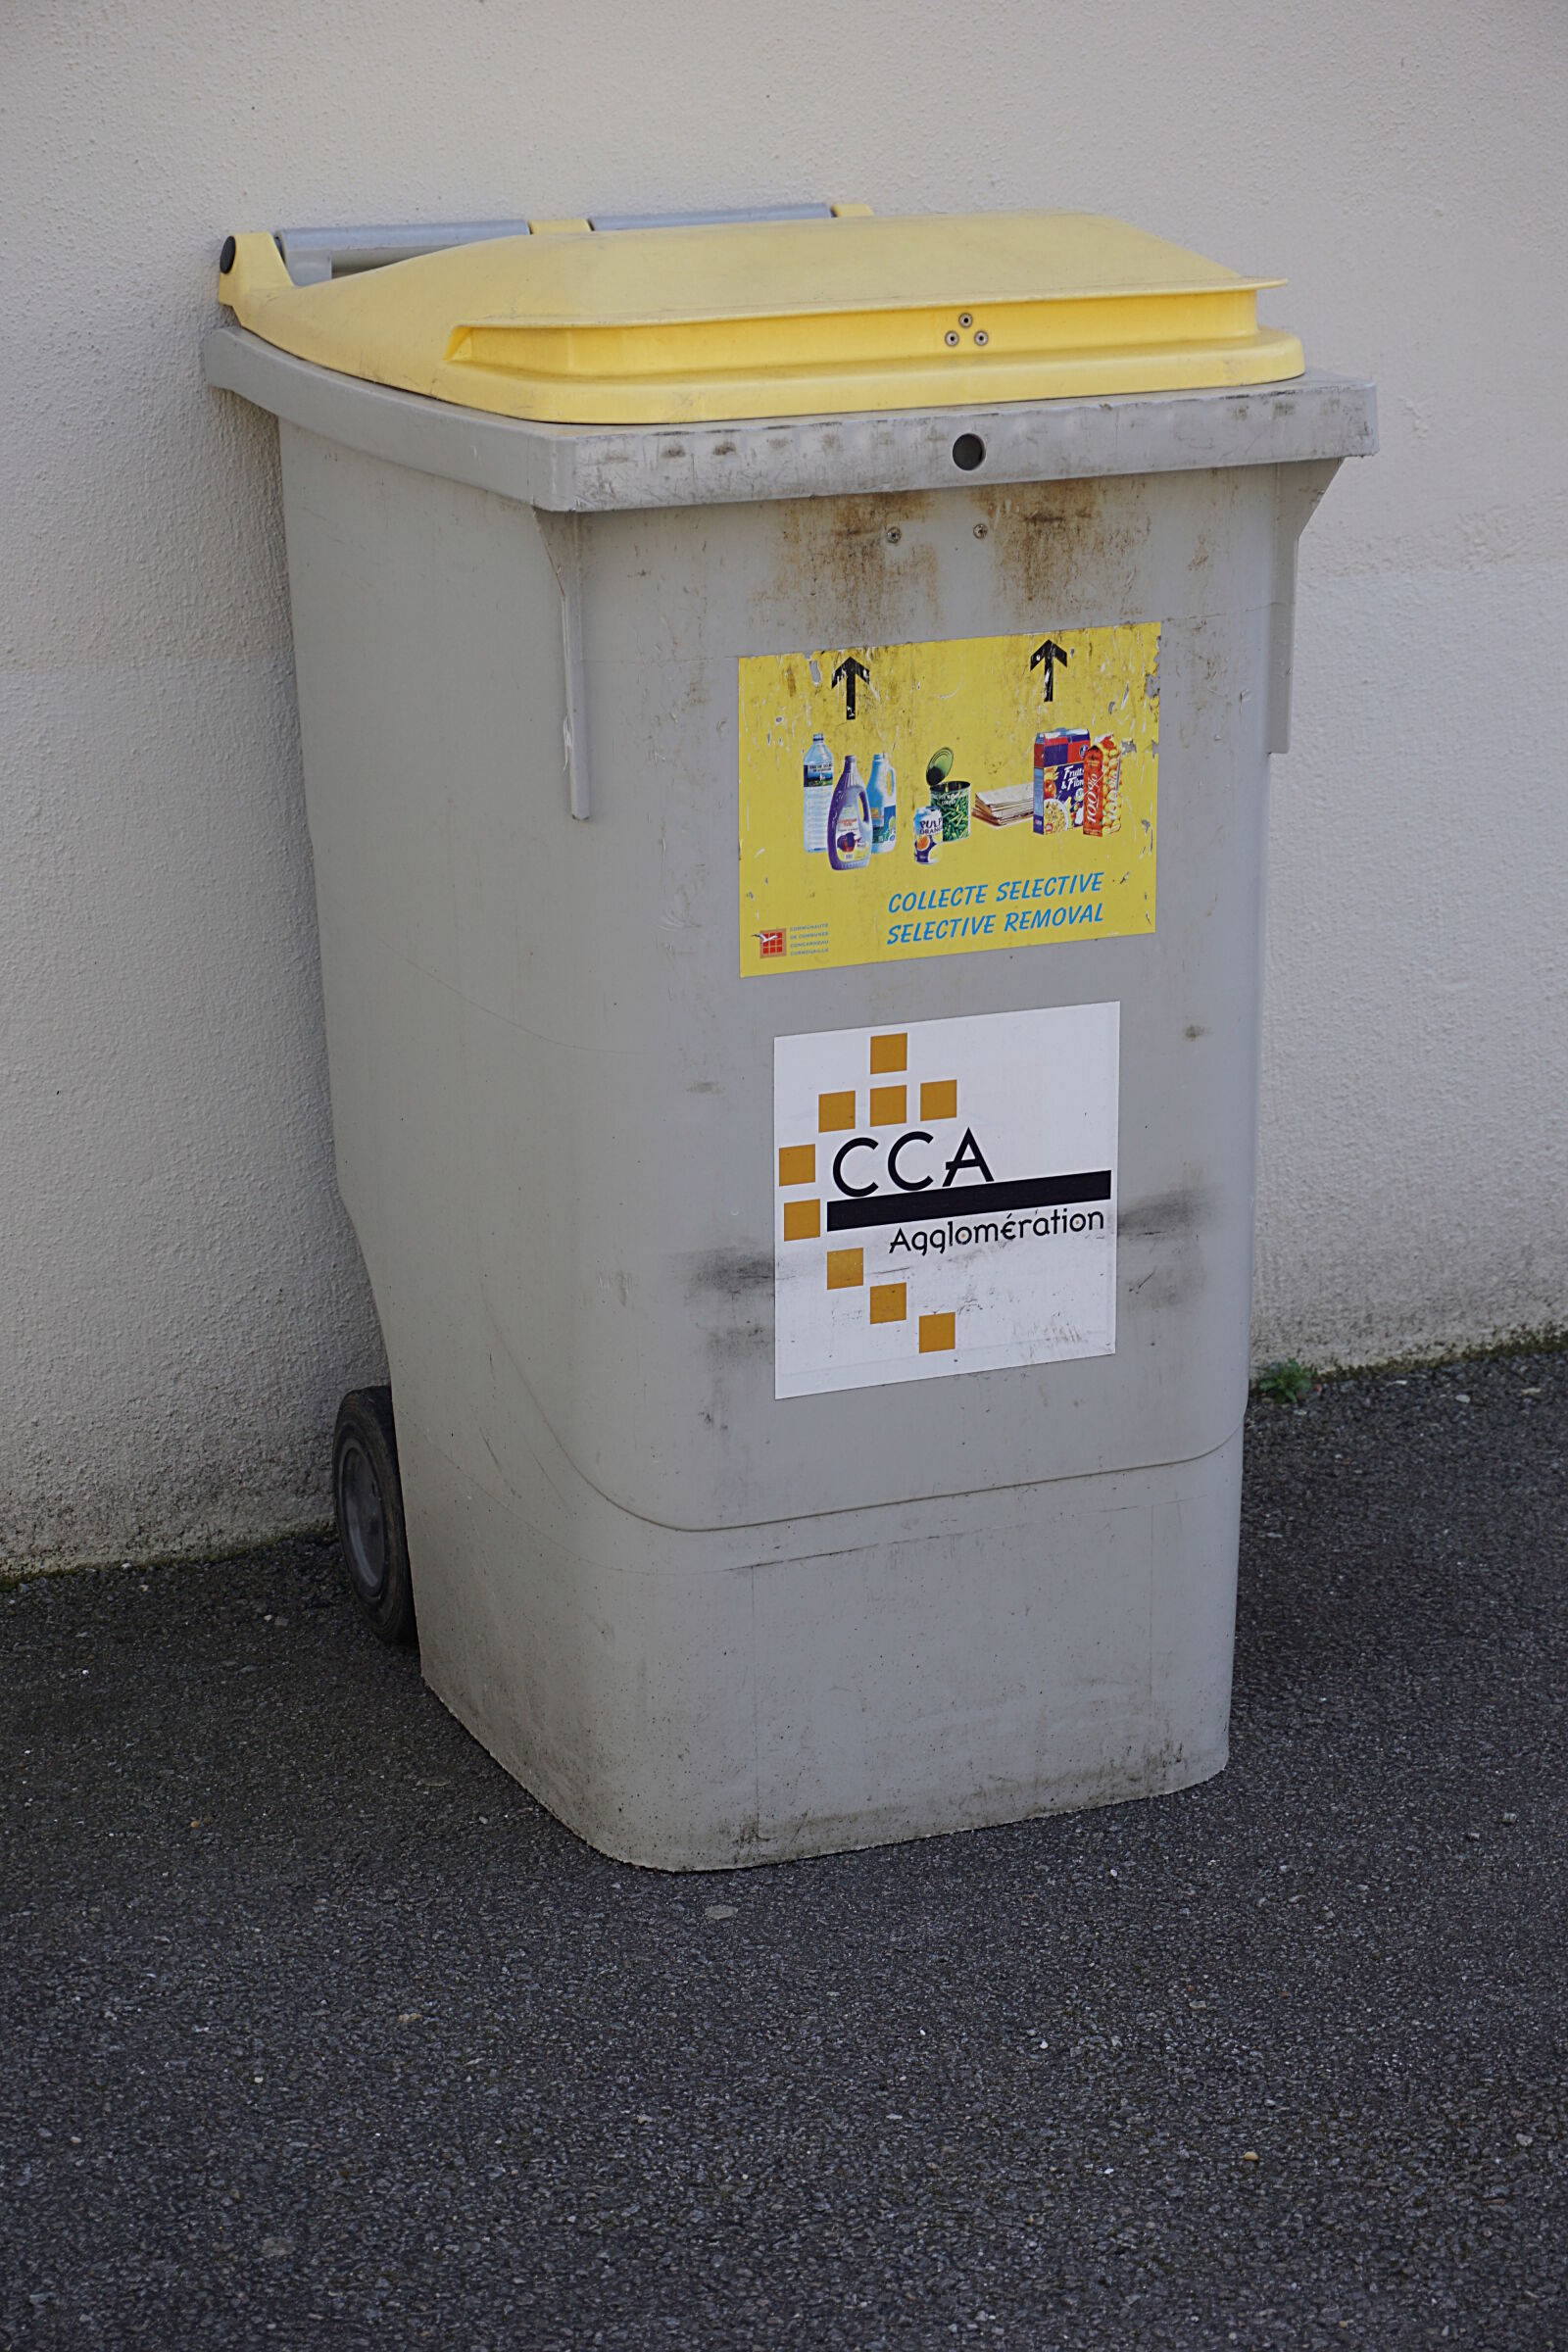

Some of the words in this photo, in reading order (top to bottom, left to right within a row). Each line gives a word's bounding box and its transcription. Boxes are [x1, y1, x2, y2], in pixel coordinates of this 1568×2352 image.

[888, 885, 988, 913] COLLECTE
[996, 872, 1104, 902] SELECTIVE
[887, 914, 997, 945] SELECTIVE
[1004, 903, 1103, 932] REMOVAL
[832, 1127, 995, 1198] CCA
[889, 1208, 1104, 1256] Agglomération
